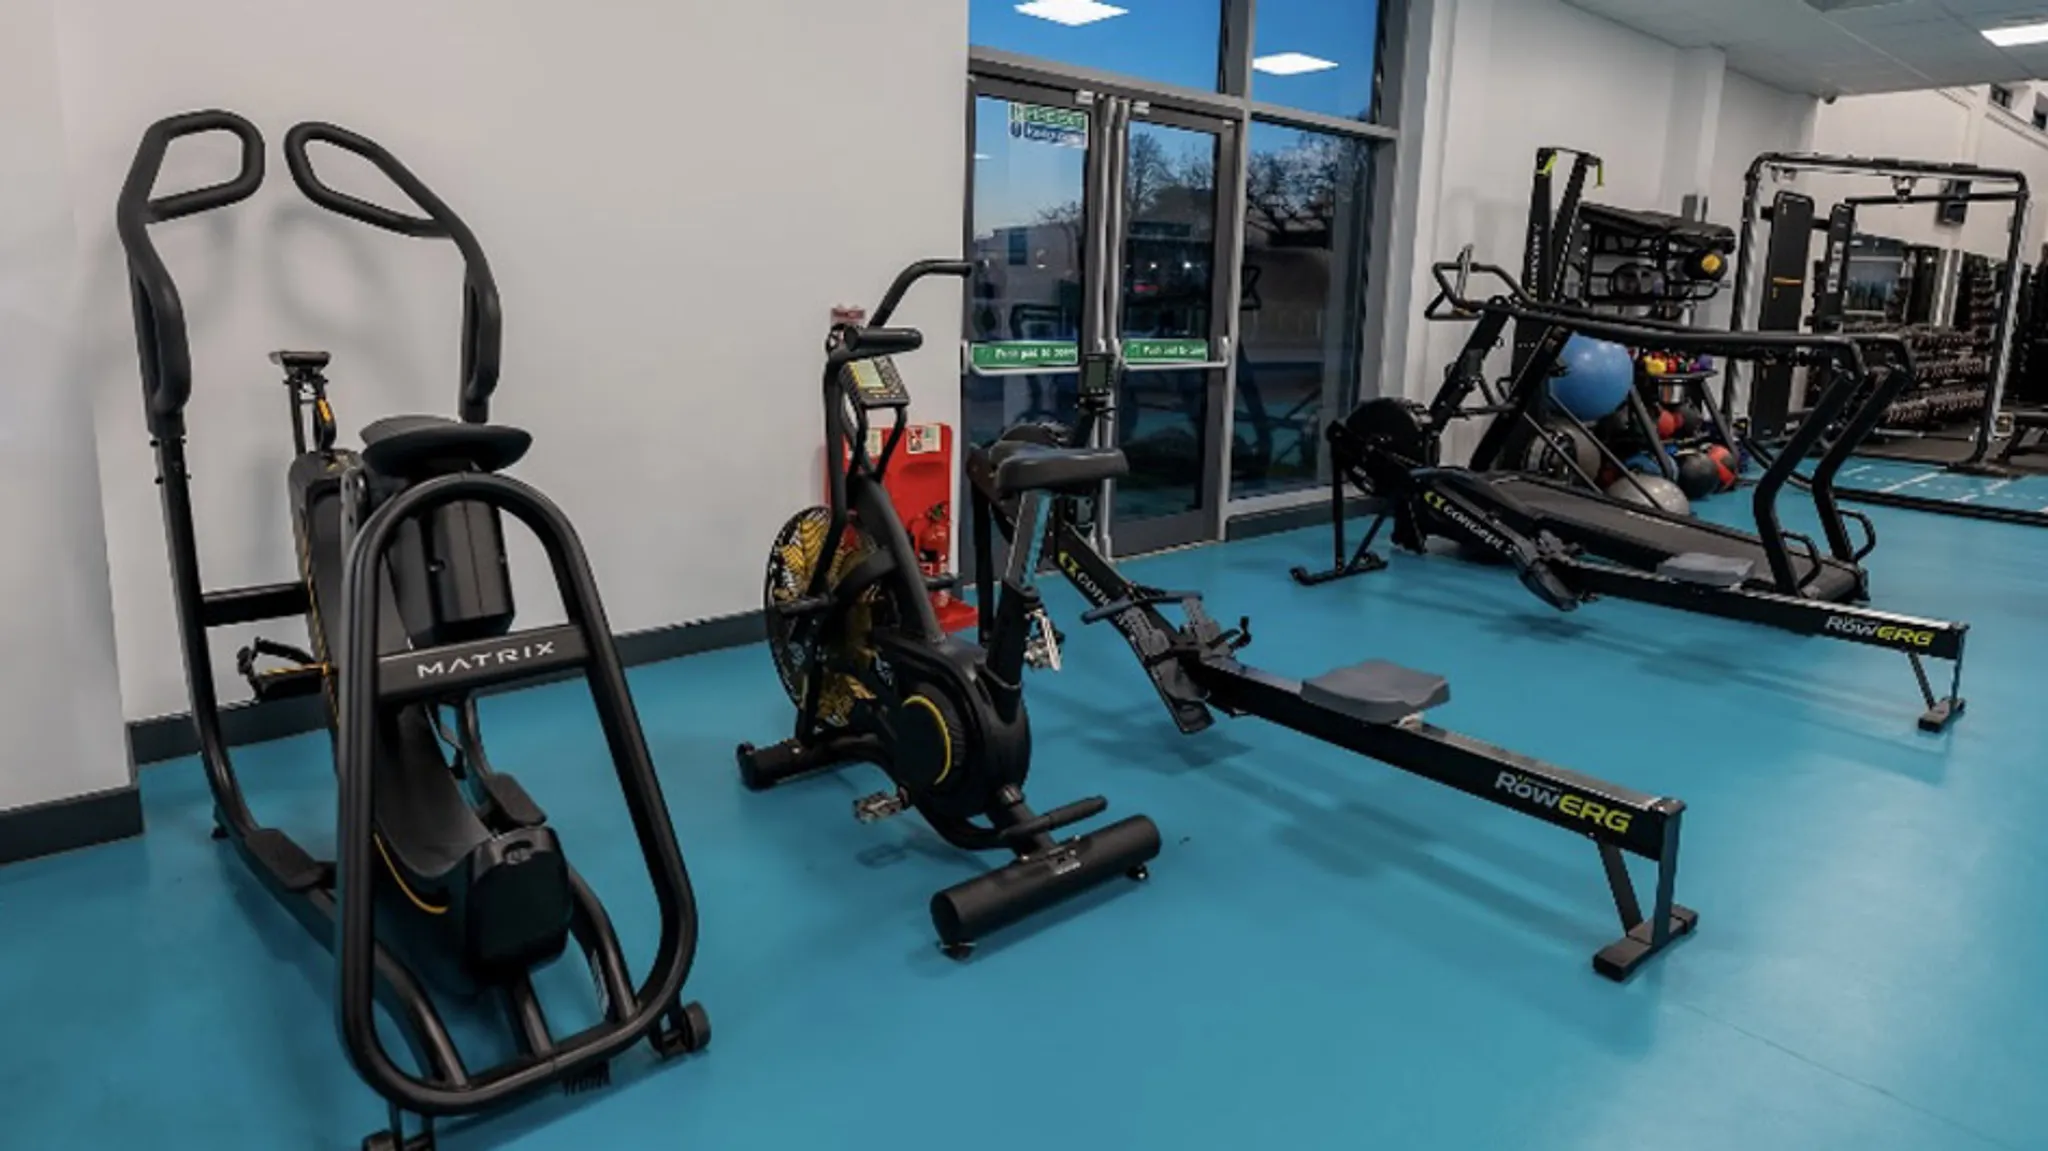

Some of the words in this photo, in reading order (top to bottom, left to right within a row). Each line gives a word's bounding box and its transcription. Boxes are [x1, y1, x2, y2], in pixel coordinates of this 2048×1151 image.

[1824, 615, 1936, 648] RowERG
[416, 641, 555, 679] MATRIX
[1494, 769, 1633, 834] RowERG
